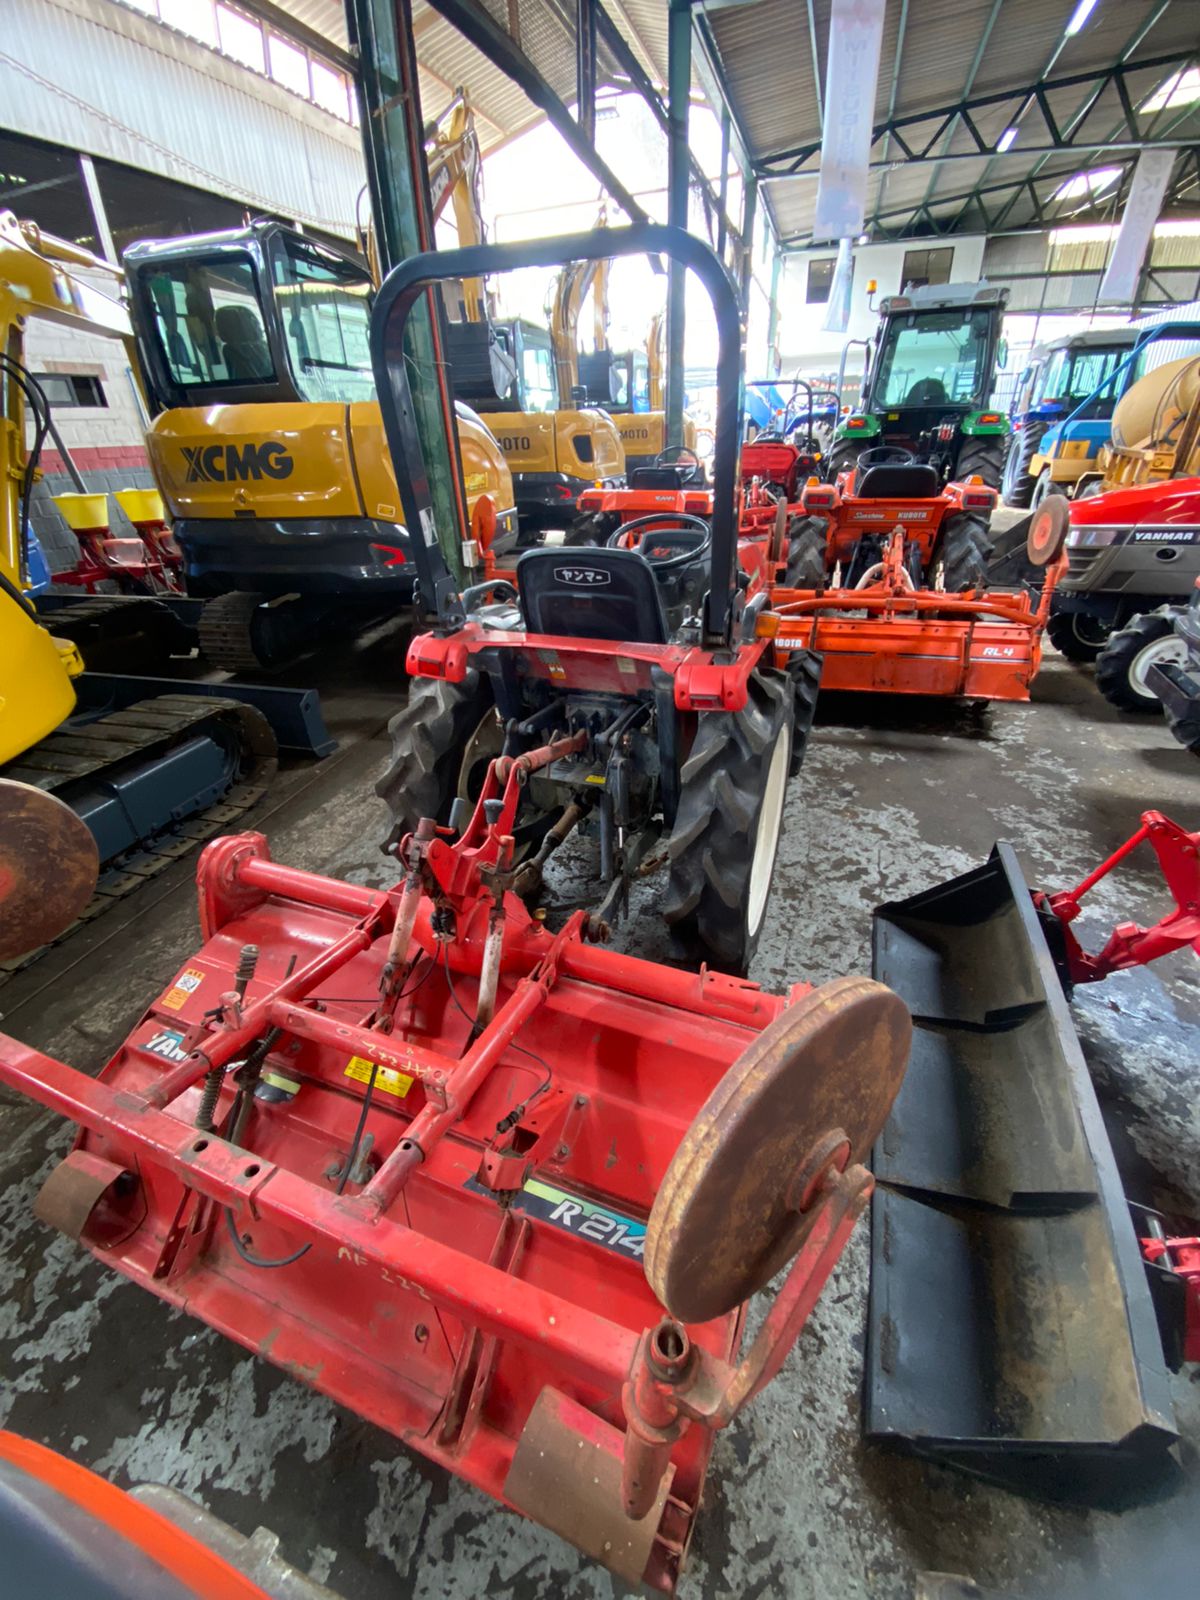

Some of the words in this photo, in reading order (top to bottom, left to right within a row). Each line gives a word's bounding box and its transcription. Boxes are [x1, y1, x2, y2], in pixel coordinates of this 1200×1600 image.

[179, 441, 294, 482] XCMG
[1135, 532, 1194, 541] YANMAR
[561, 569, 603, 583] ヤンマー
